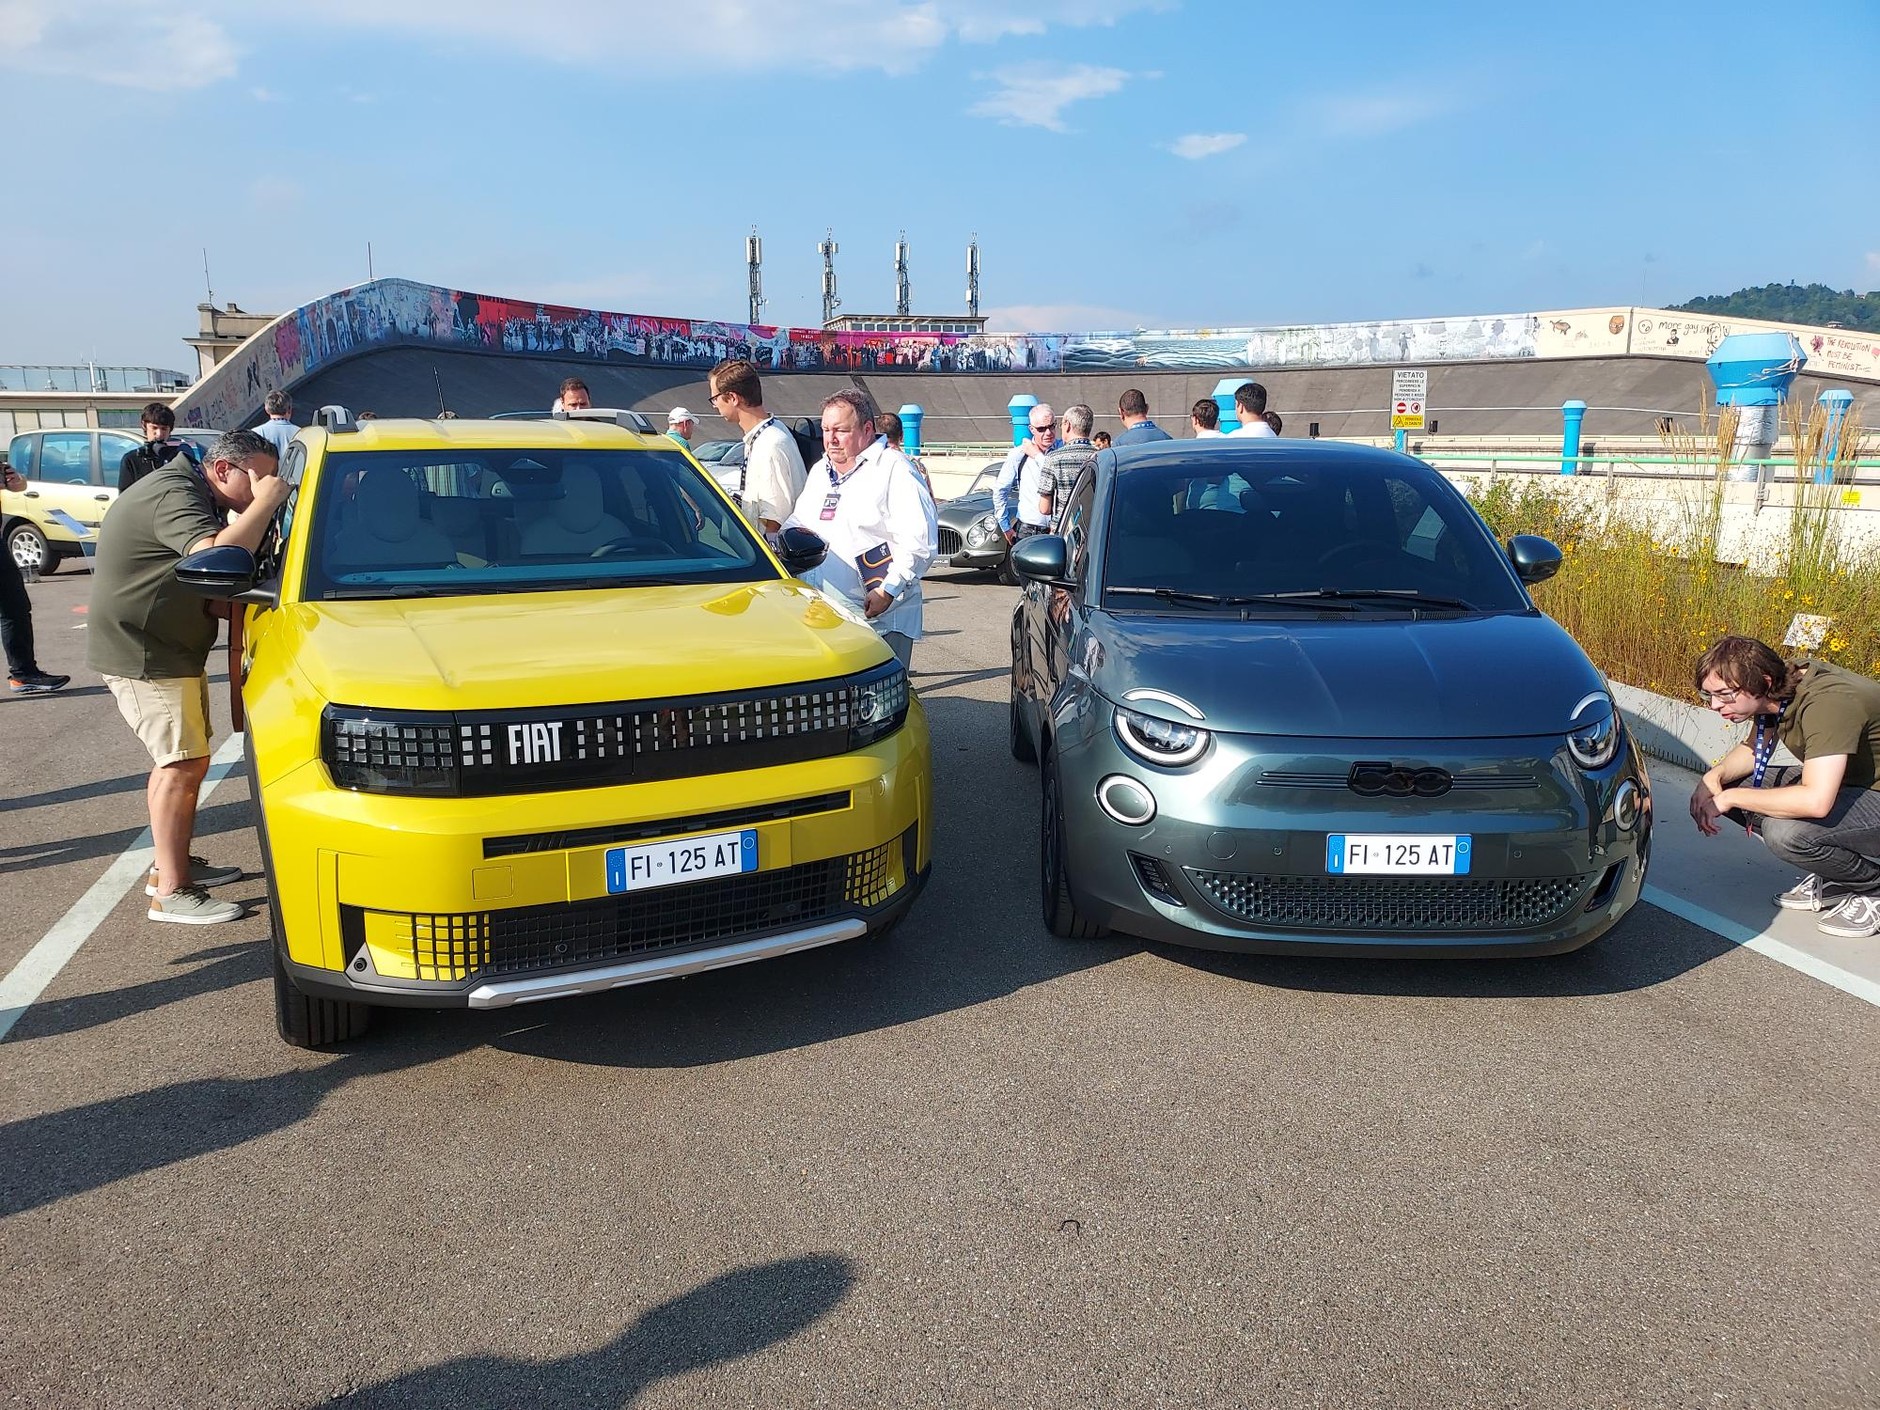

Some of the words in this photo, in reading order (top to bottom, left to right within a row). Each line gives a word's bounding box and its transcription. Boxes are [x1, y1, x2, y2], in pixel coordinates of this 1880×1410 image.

[1658, 321, 1682, 330] more
[1683, 322, 1699, 336] gay
[1827, 337, 1837, 346] THE
[1838, 339, 1871, 353] REVOLUTION
[1827, 350, 1841, 359] MUST
[1842, 352, 1853, 361] BE
[1828, 360, 1861, 372] FEMINIST
[1397, 371, 1425, 379] VIETATO
[508, 722, 563, 765] FIAT
[631, 855, 651, 880] FI
[668, 847, 706, 874] 125
[714, 841, 739, 867] AT
[1350, 845, 1368, 865] FI
[1385, 845, 1420, 865] 125
[1428, 845, 1453, 865] AT
